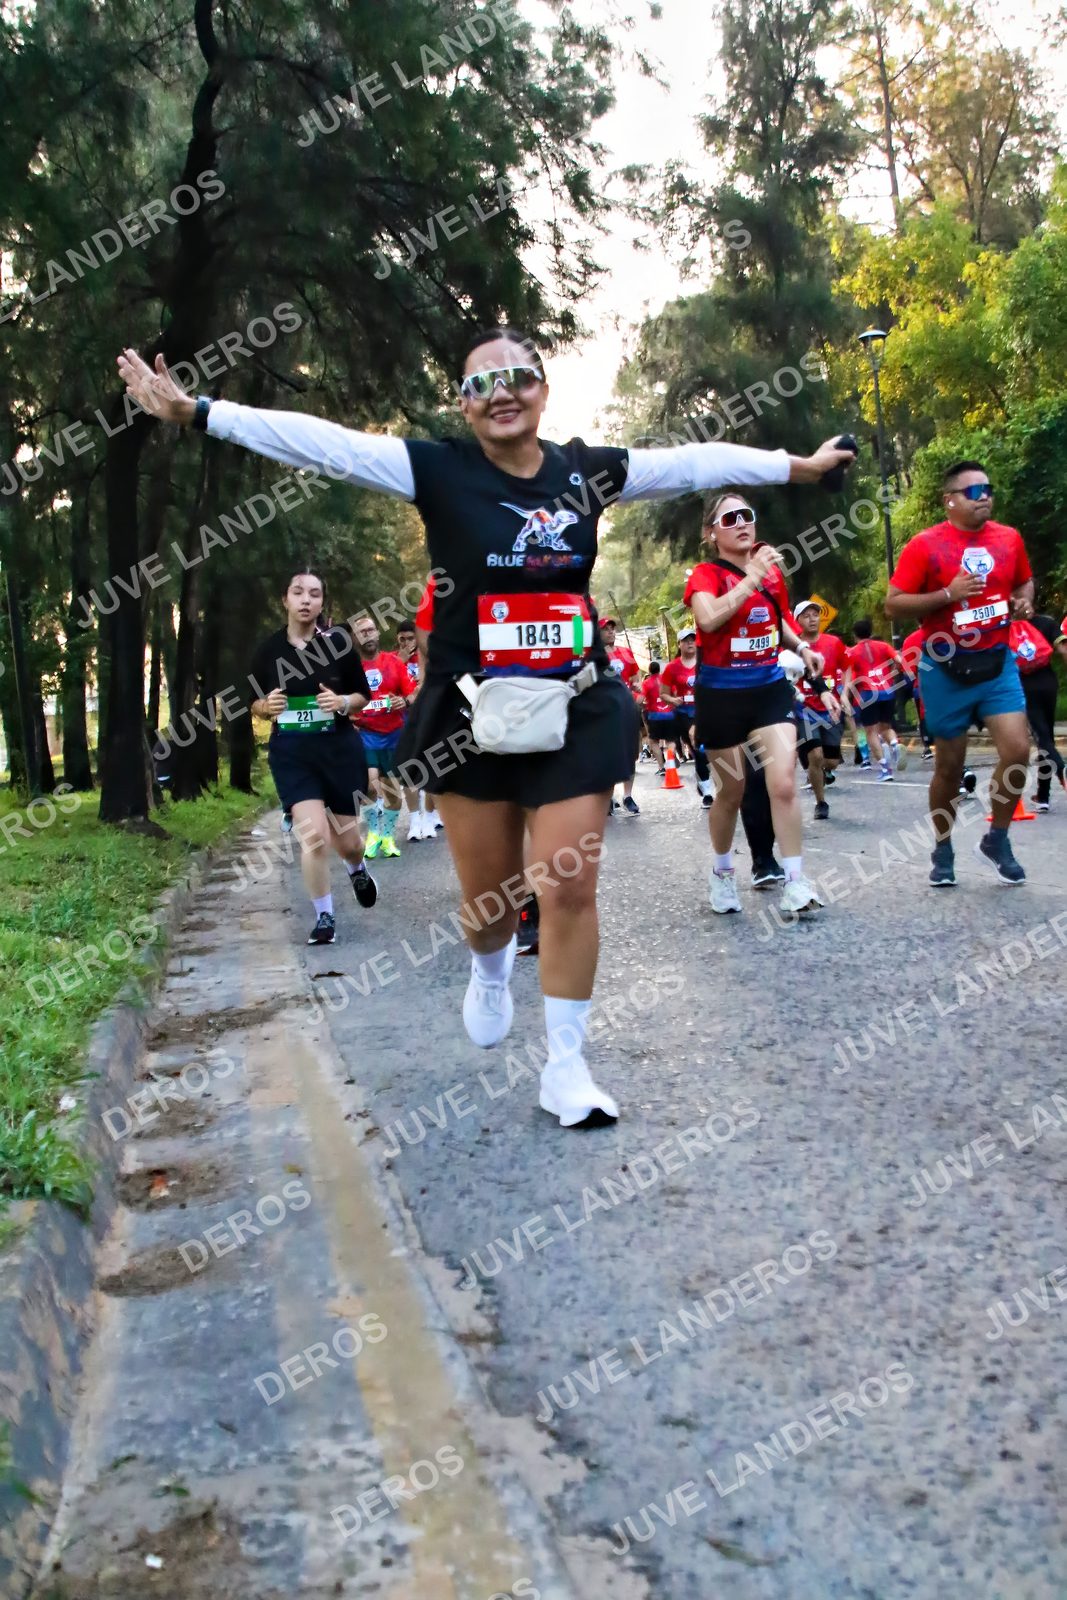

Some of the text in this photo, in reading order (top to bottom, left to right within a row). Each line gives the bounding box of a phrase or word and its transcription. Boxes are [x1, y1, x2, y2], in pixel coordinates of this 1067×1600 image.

[486, 553, 526, 568] BLUE
[973, 605, 996, 621] 2500
[515, 623, 562, 647] 1843
[749, 636, 770, 650] 2499
[296, 711, 314, 722] 221
